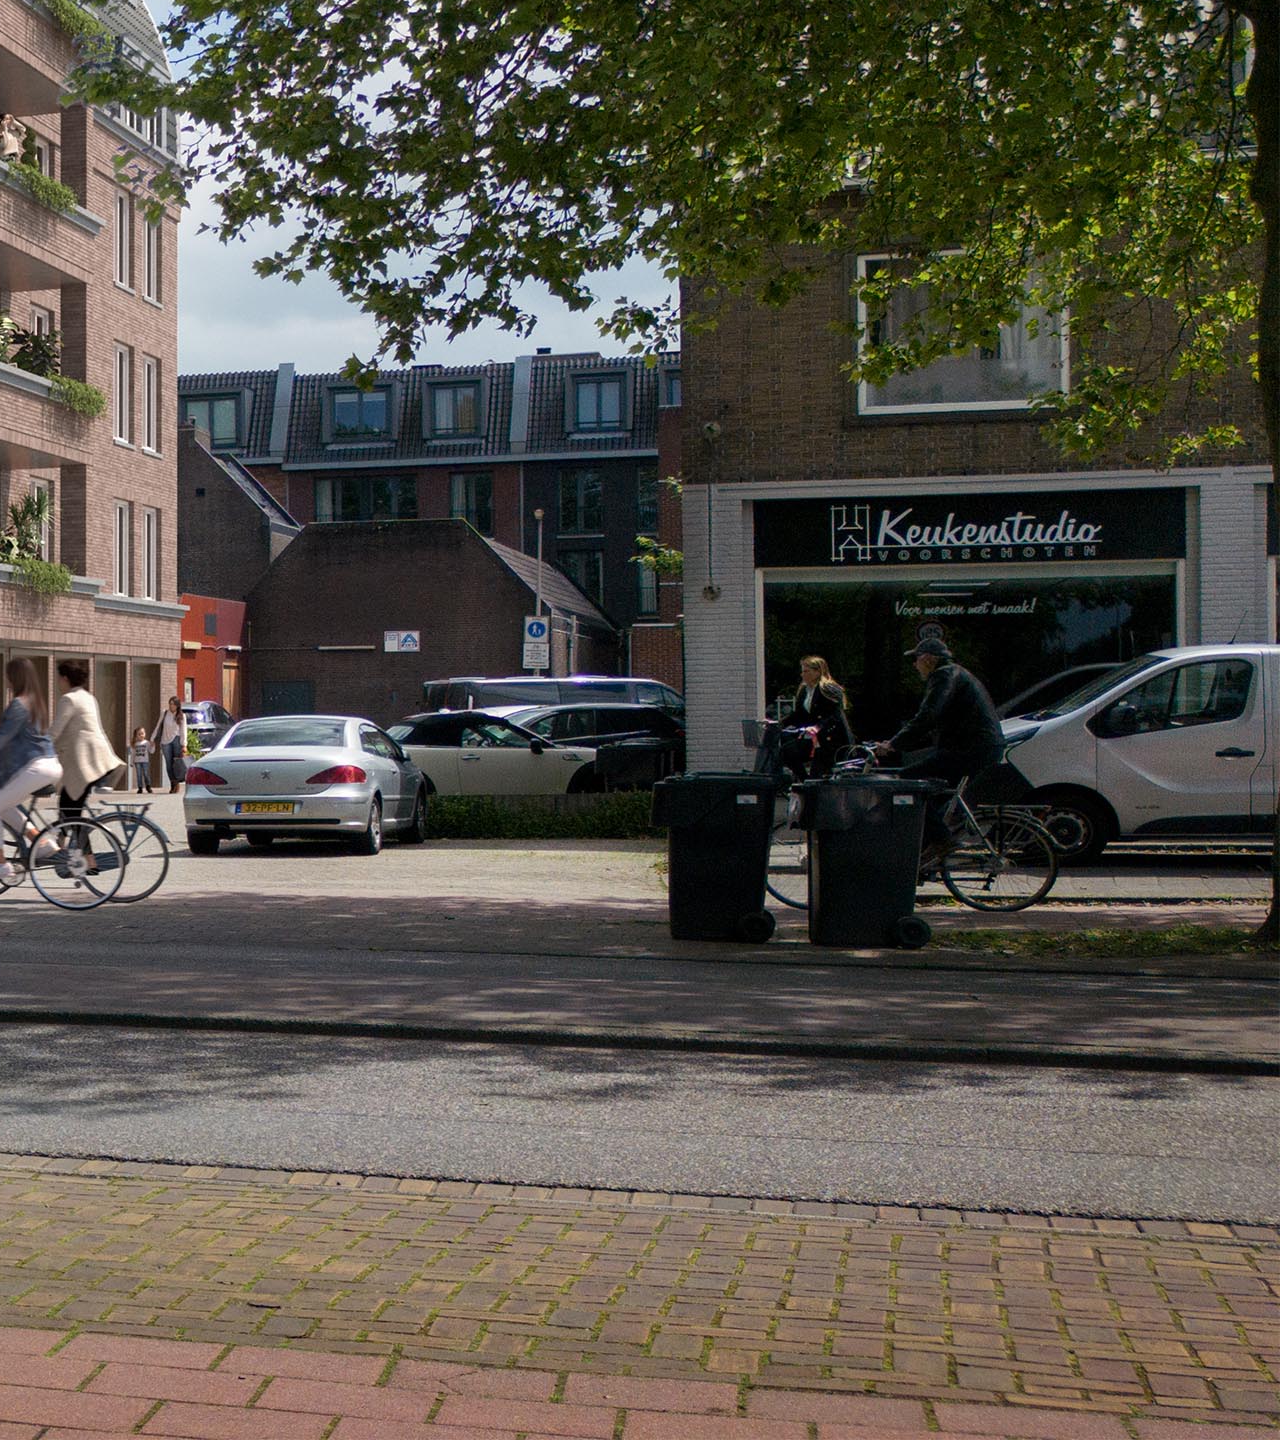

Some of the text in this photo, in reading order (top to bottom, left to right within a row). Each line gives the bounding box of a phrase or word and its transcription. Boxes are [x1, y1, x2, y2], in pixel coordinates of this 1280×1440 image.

[877, 508, 1103, 546] Keukenstudio
[877, 545, 1096, 560] VOORSCHOTEN
[895, 597, 1037, 616] Voor mensen met smaak!
